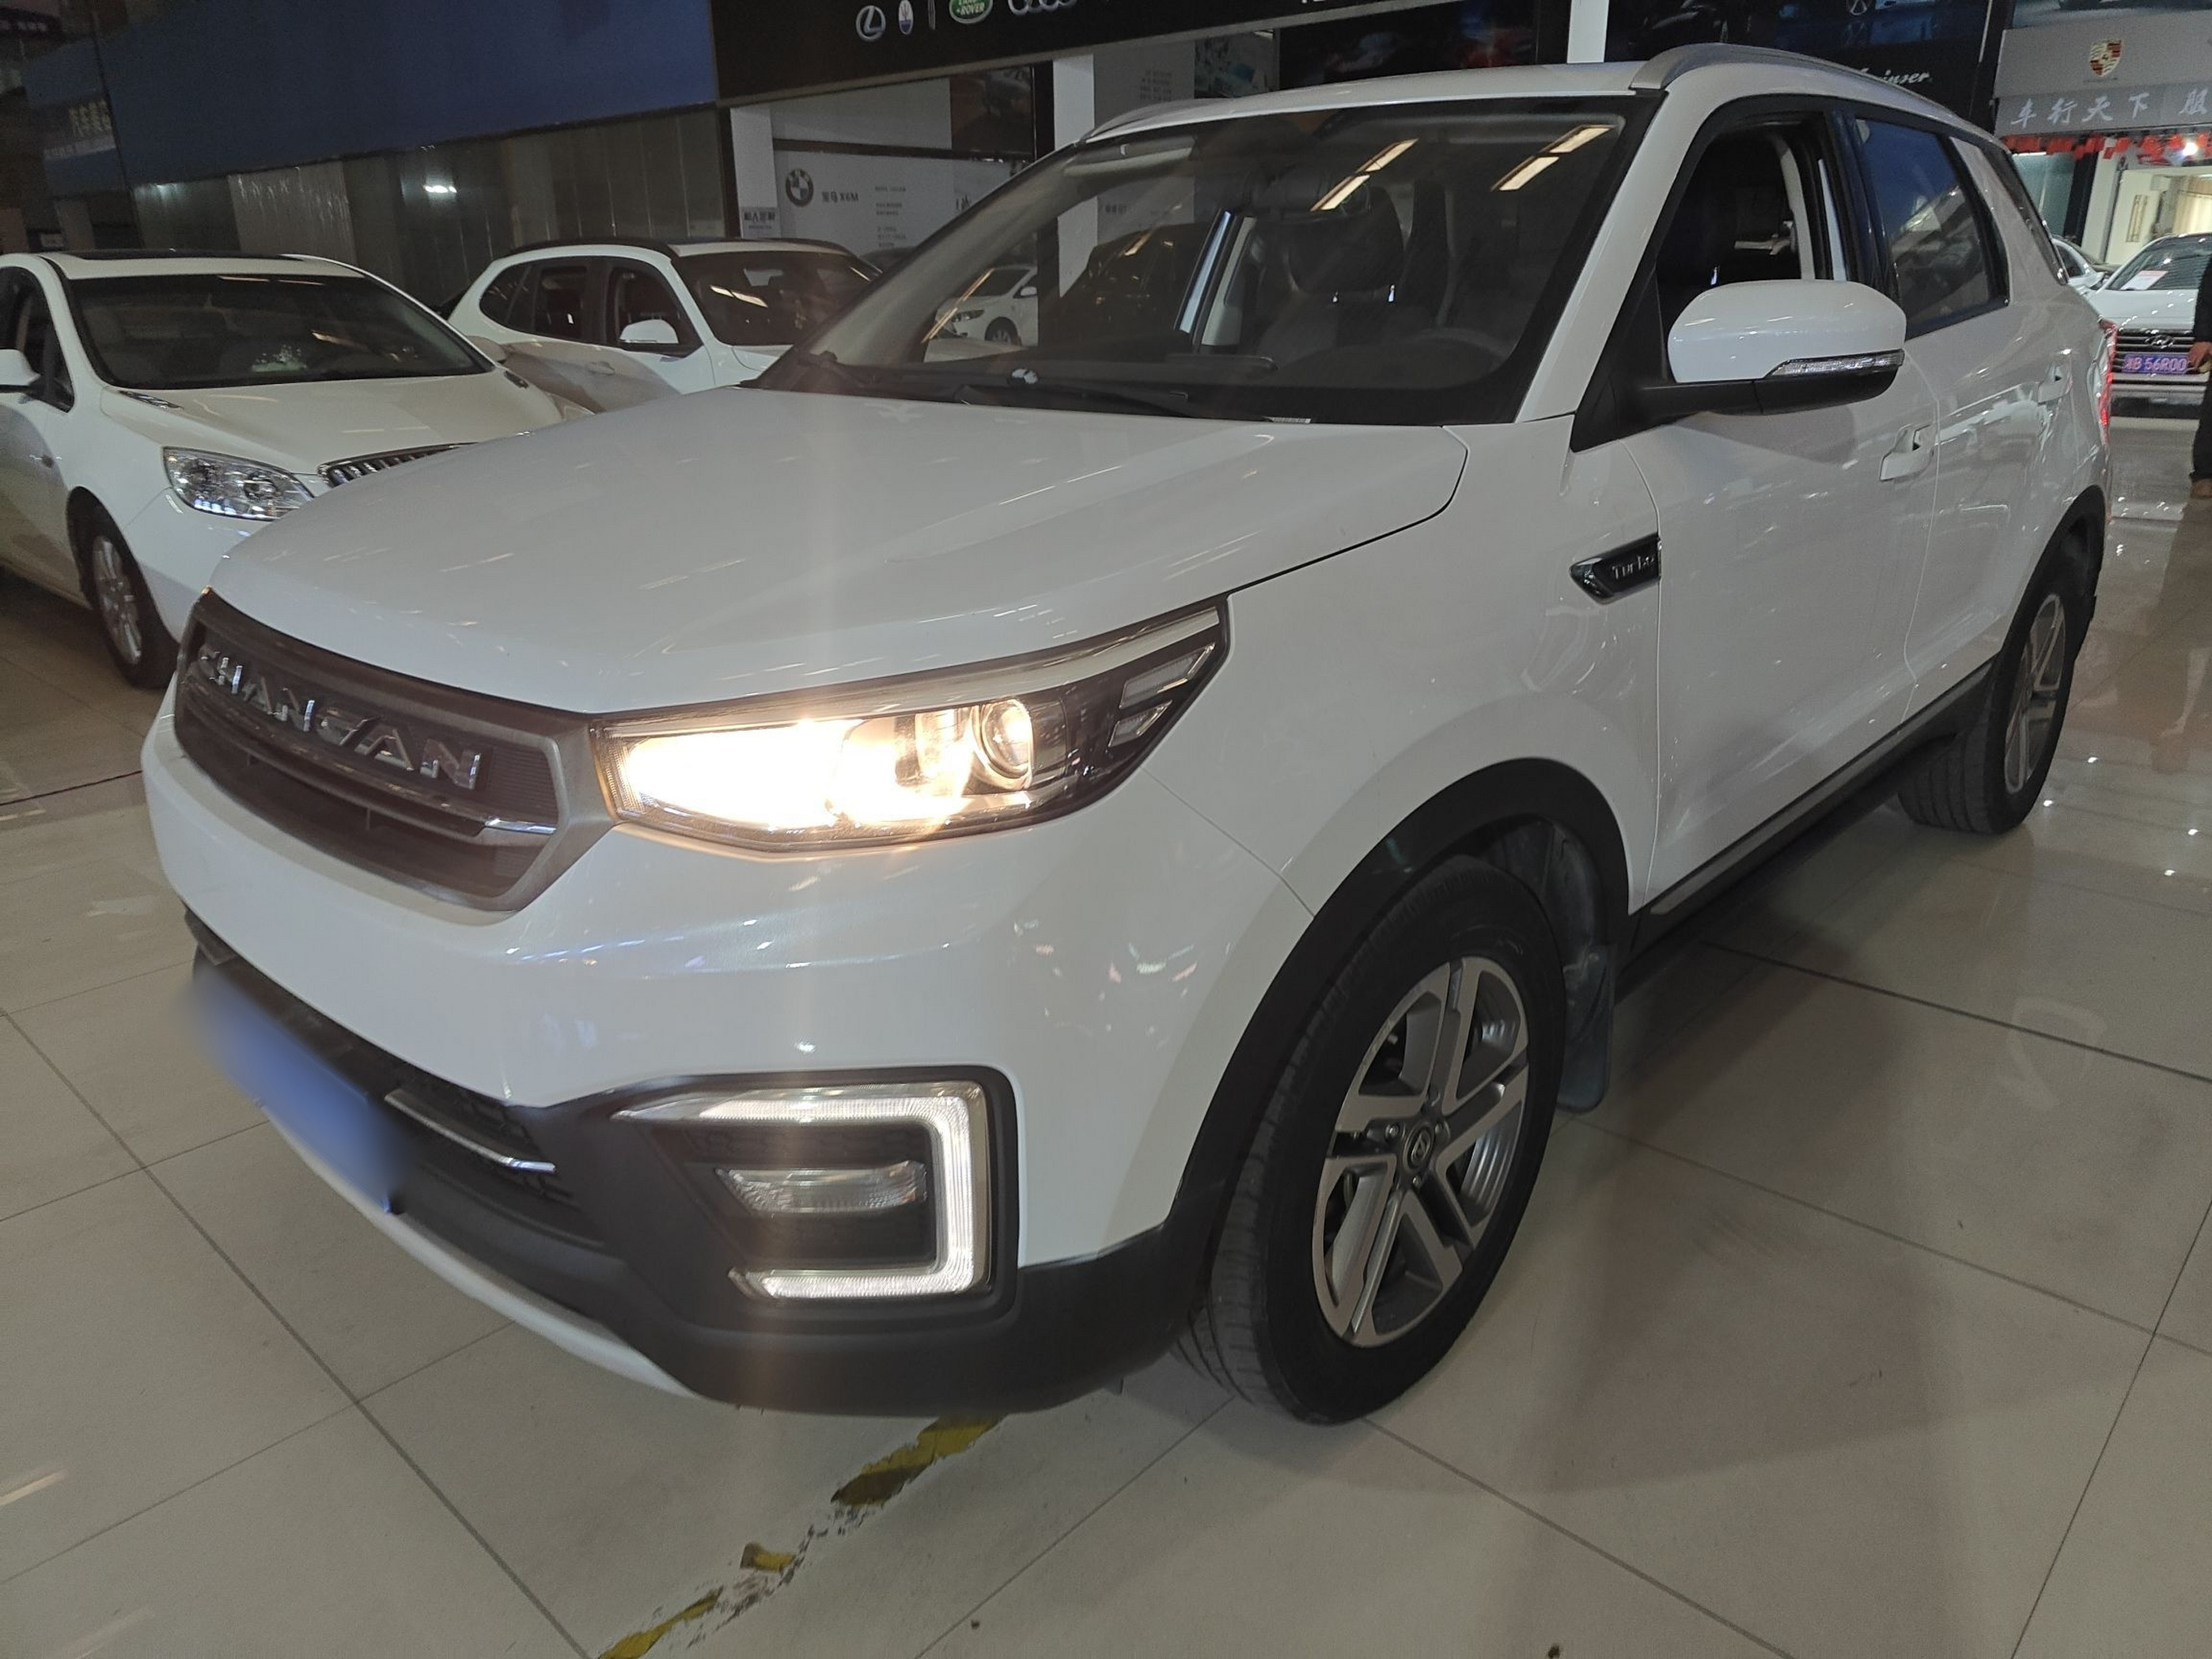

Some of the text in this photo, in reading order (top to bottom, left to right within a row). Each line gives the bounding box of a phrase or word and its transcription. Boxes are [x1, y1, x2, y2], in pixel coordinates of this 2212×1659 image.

[960, 2, 985, 16] ROVER
[2010, 92, 2149, 130] 车行天下
[840, 192, 859, 202] X6M
